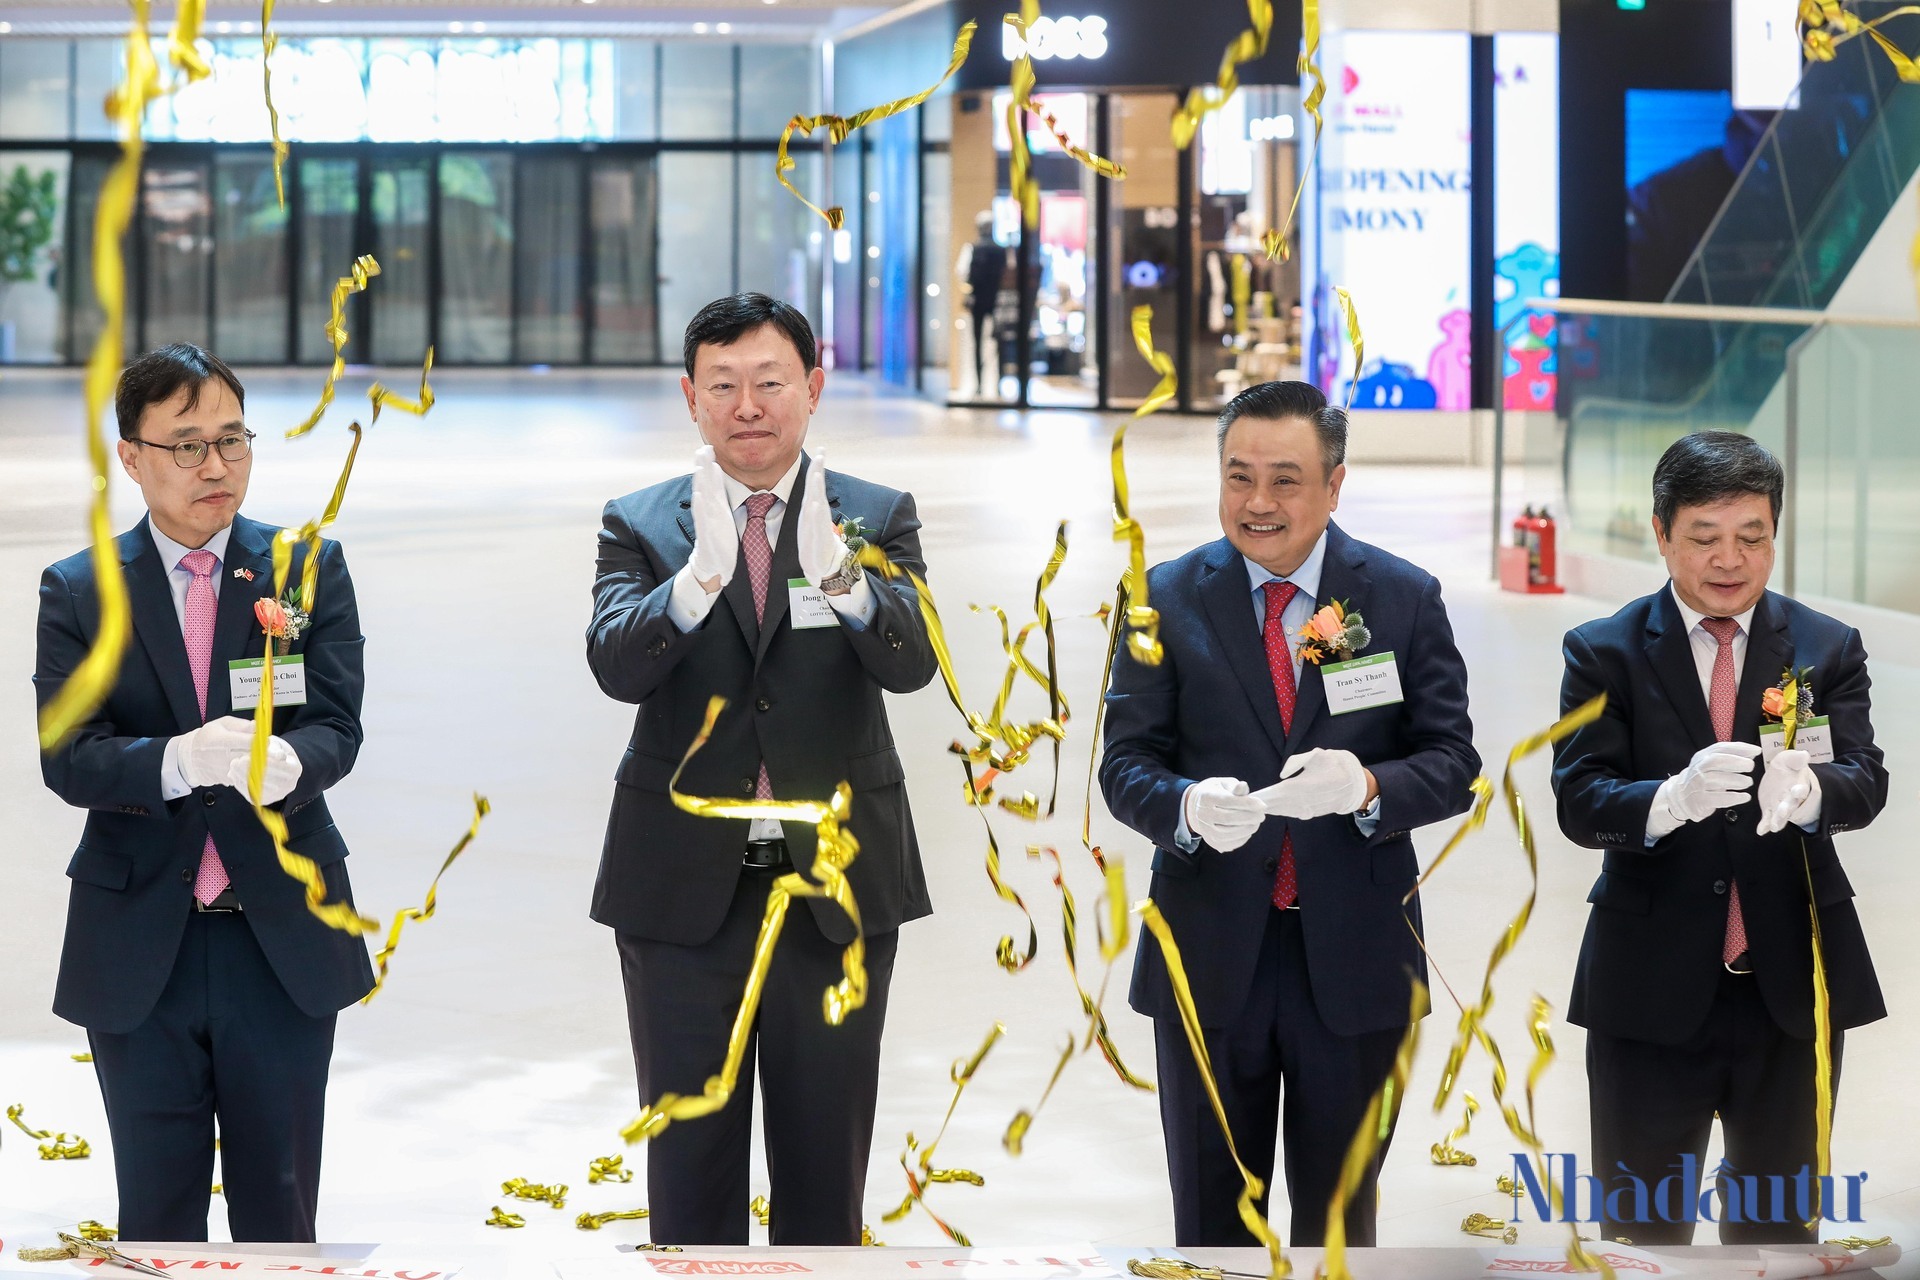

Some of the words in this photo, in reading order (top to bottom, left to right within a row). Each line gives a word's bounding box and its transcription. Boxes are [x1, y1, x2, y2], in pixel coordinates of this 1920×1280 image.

[1002, 15, 1108, 61] BOSS
[802, 594, 821, 602] Dong
[239, 675, 262, 684] Young
[280, 671, 297, 680] Choi
[1336, 679, 1353, 688] Tran
[1354, 676, 1363, 684] Sy
[1364, 671, 1388, 681] Thanh
[1806, 735, 1820, 743] Viet
[264, 1264, 442, 1280] OTTE
